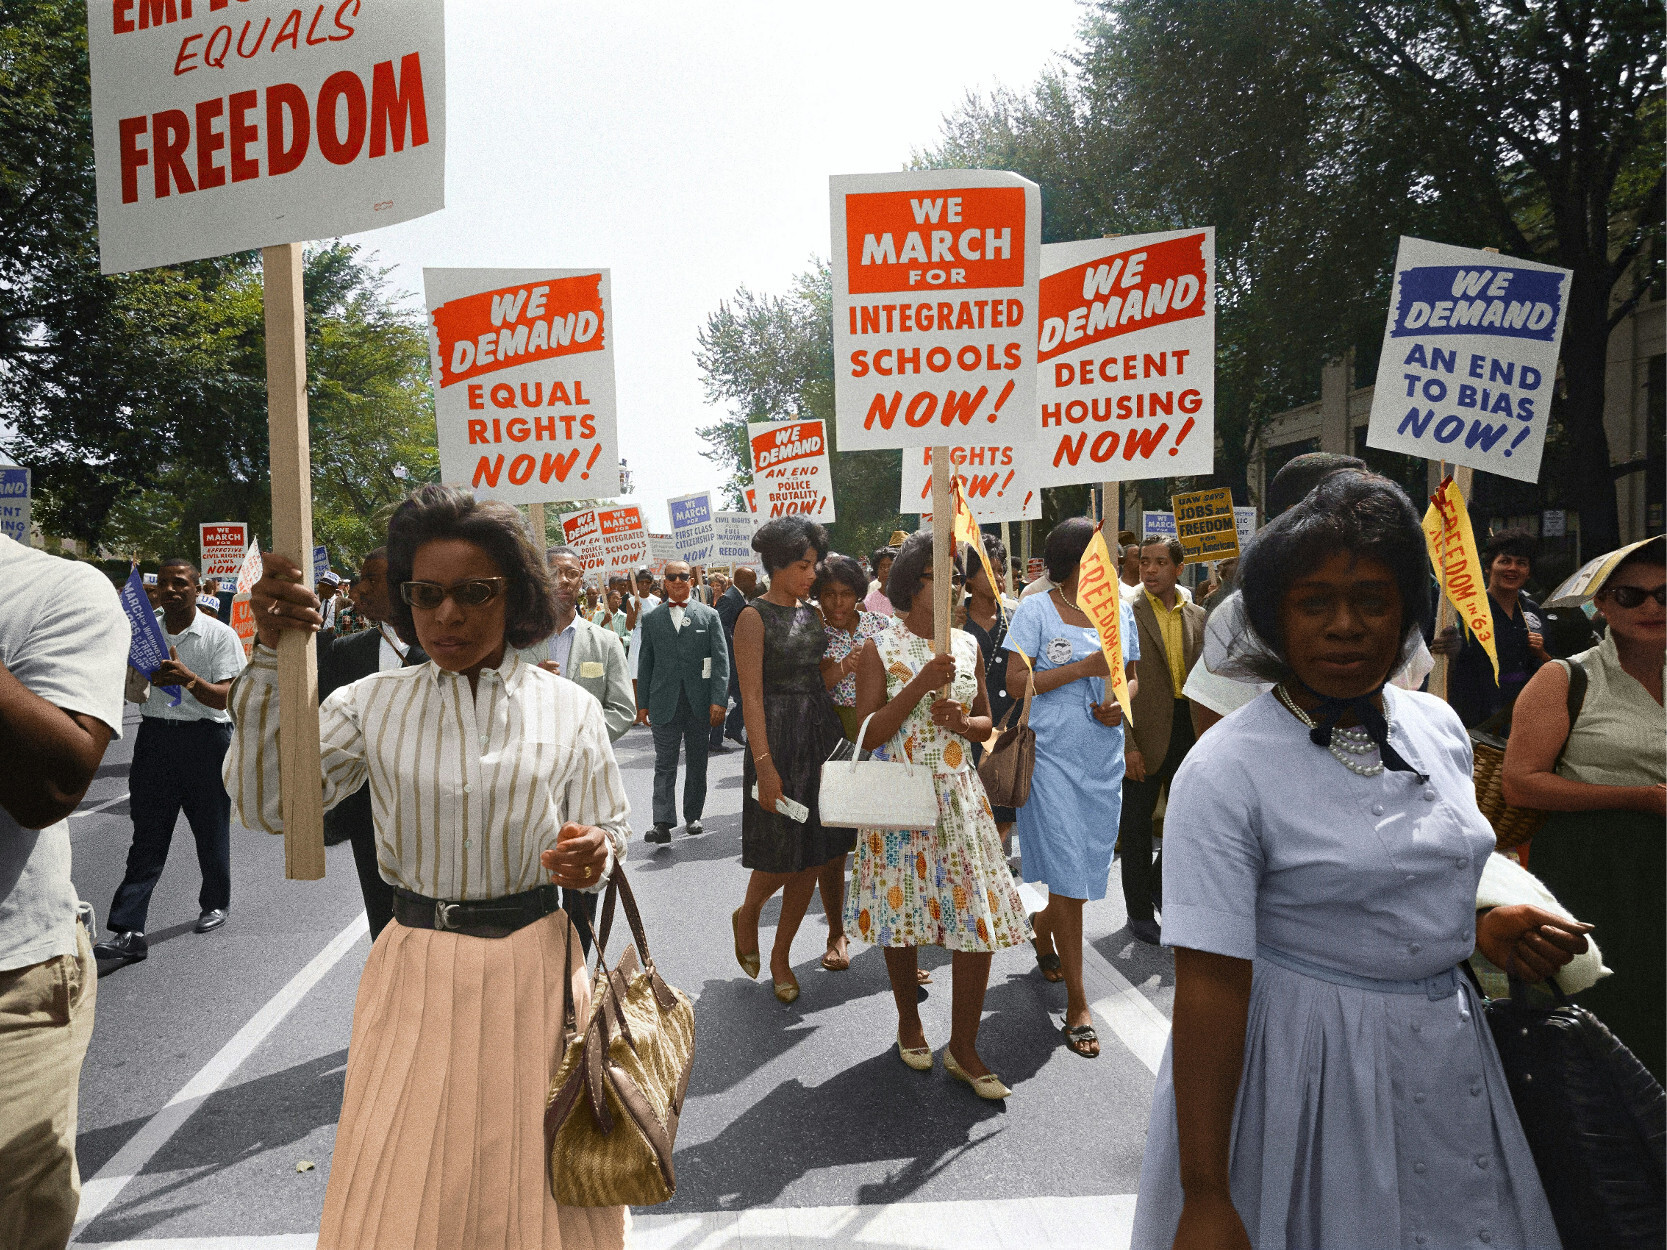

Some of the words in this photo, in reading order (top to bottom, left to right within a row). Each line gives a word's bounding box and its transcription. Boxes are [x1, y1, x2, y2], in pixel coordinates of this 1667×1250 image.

[174, 0, 361, 76] EQUALS
[119, 51, 429, 205] FREEDOM
[910, 197, 962, 224] WE
[861, 228, 1011, 265] MARCH
[909, 268, 966, 285] FOR
[1083, 252, 1147, 300] WE
[1451, 269, 1513, 297] WE
[491, 285, 550, 327] WE
[849, 299, 1024, 335] INTEGRATED
[1039, 274, 1199, 353] DEMAND
[1404, 300, 1553, 331] DEMAND
[450, 310, 598, 374] DEMAND
[850, 343, 1022, 378] SCHOOLS
[1055, 350, 1189, 387] DECENT
[1404, 343, 1457, 374] AN
[1469, 354, 1541, 391] END
[468, 381, 590, 410] EQUAL
[864, 378, 1015, 430] NOW!
[1042, 389, 1203, 427] HOUSING
[1404, 374, 1447, 402] TO
[1457, 384, 1535, 422] BIAS
[468, 414, 596, 444] RIGHTS
[775, 427, 800, 445] WE
[1052, 416, 1195, 468] NOW!
[1397, 407, 1530, 457] NOW!
[758, 436, 821, 467] DEMAND
[923, 446, 1013, 465] RGHTS
[472, 443, 602, 488] NOW!
[765, 468, 787, 479] AN
[791, 466, 818, 476] END
[769, 490, 818, 502] BRUTALITY
[778, 481, 811, 491] POLICE
[0, 507, 21, 517] NT
[676, 506, 707, 521] MARCH
[684, 500, 696, 509] WE
[770, 495, 826, 518] NOW!
[1178, 496, 1202, 506] UAW
[1178, 504, 1213, 521] JOBS
[577, 512, 593, 526] WE
[603, 516, 638, 529] MARCH
[675, 529, 693, 540] FIRST
[694, 524, 713, 536] CLASS
[1179, 517, 1233, 537] FREEDOM
[603, 531, 645, 544] INTEGRATED
[605, 541, 646, 554] SCHOOLS
[675, 533, 714, 549] CITIZENSHIP
[1202, 541, 1235, 553] American
[611, 550, 646, 566] NOW!
[683, 544, 714, 562] NOW!
[719, 547, 750, 557] REEDOM
[207, 565, 242, 575] NOW!
[124, 581, 144, 619] MARCH
[1078, 552, 1119, 652] FREEDOM
[139, 639, 161, 671] FREEDO
